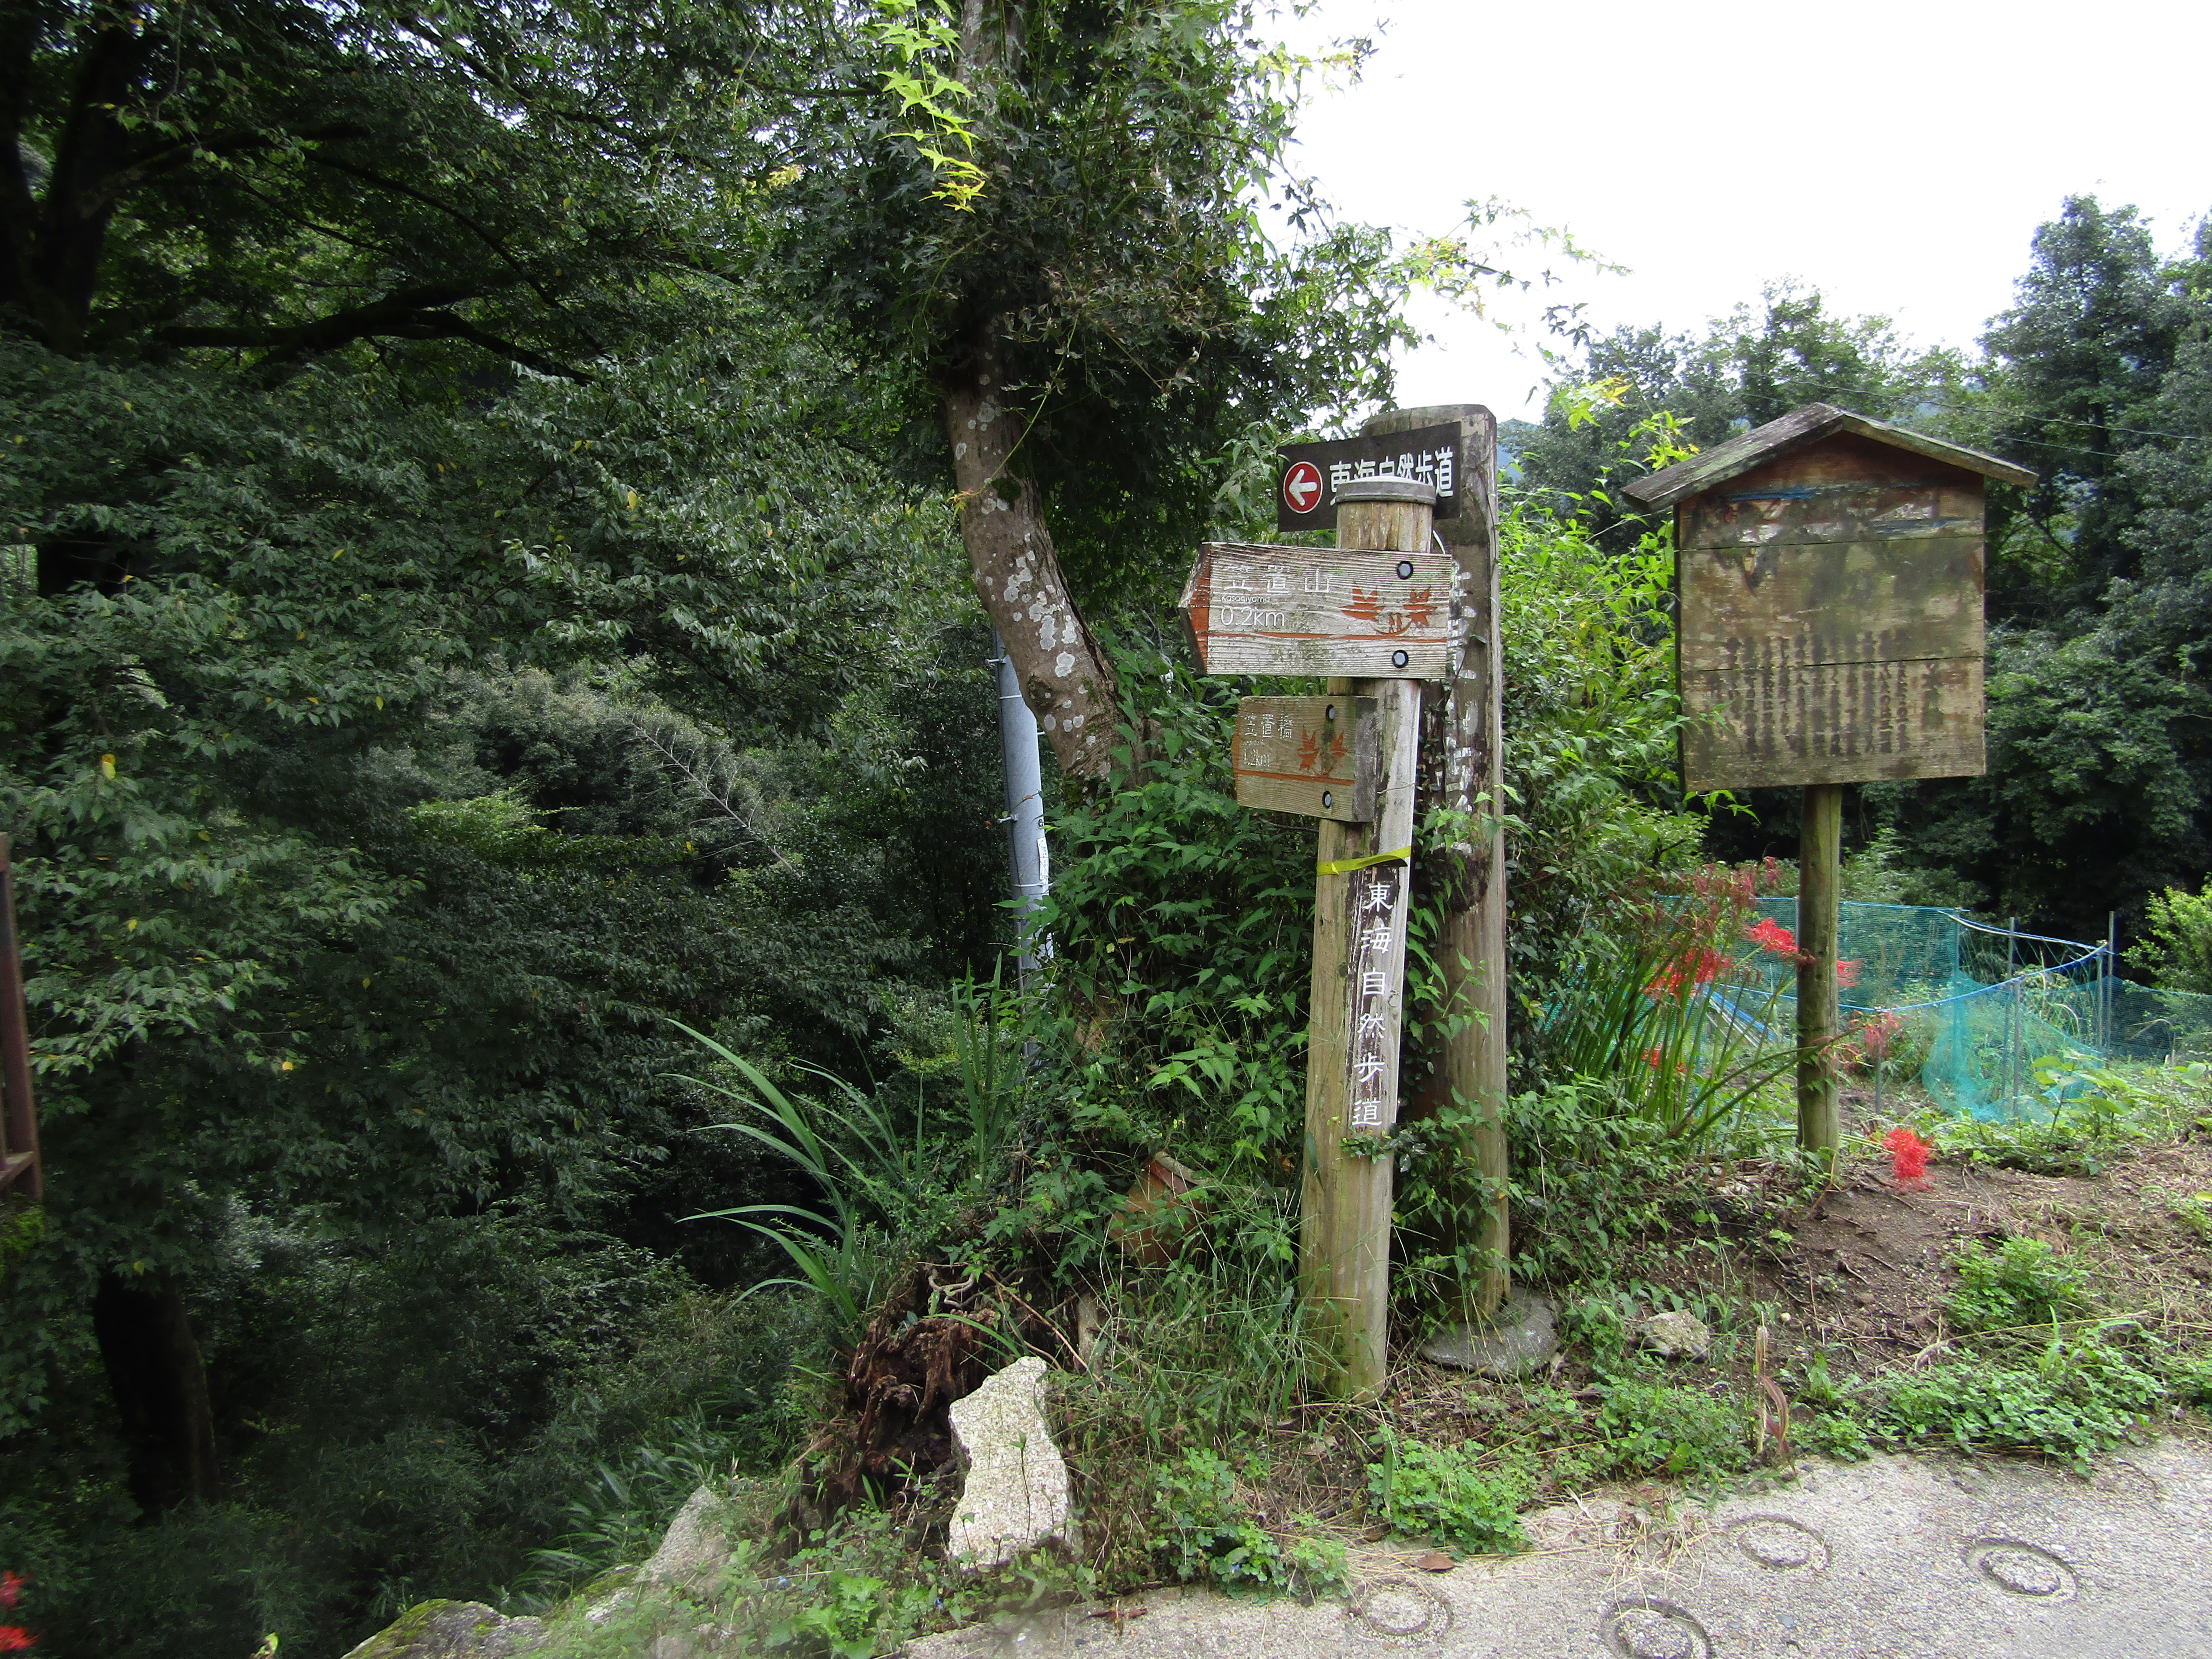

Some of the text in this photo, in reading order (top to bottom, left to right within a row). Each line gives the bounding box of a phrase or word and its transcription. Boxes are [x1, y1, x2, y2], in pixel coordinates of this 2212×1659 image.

[1221, 606, 1285, 626] 0.2km
[1352, 882, 1393, 1127] 東海自然歩道
